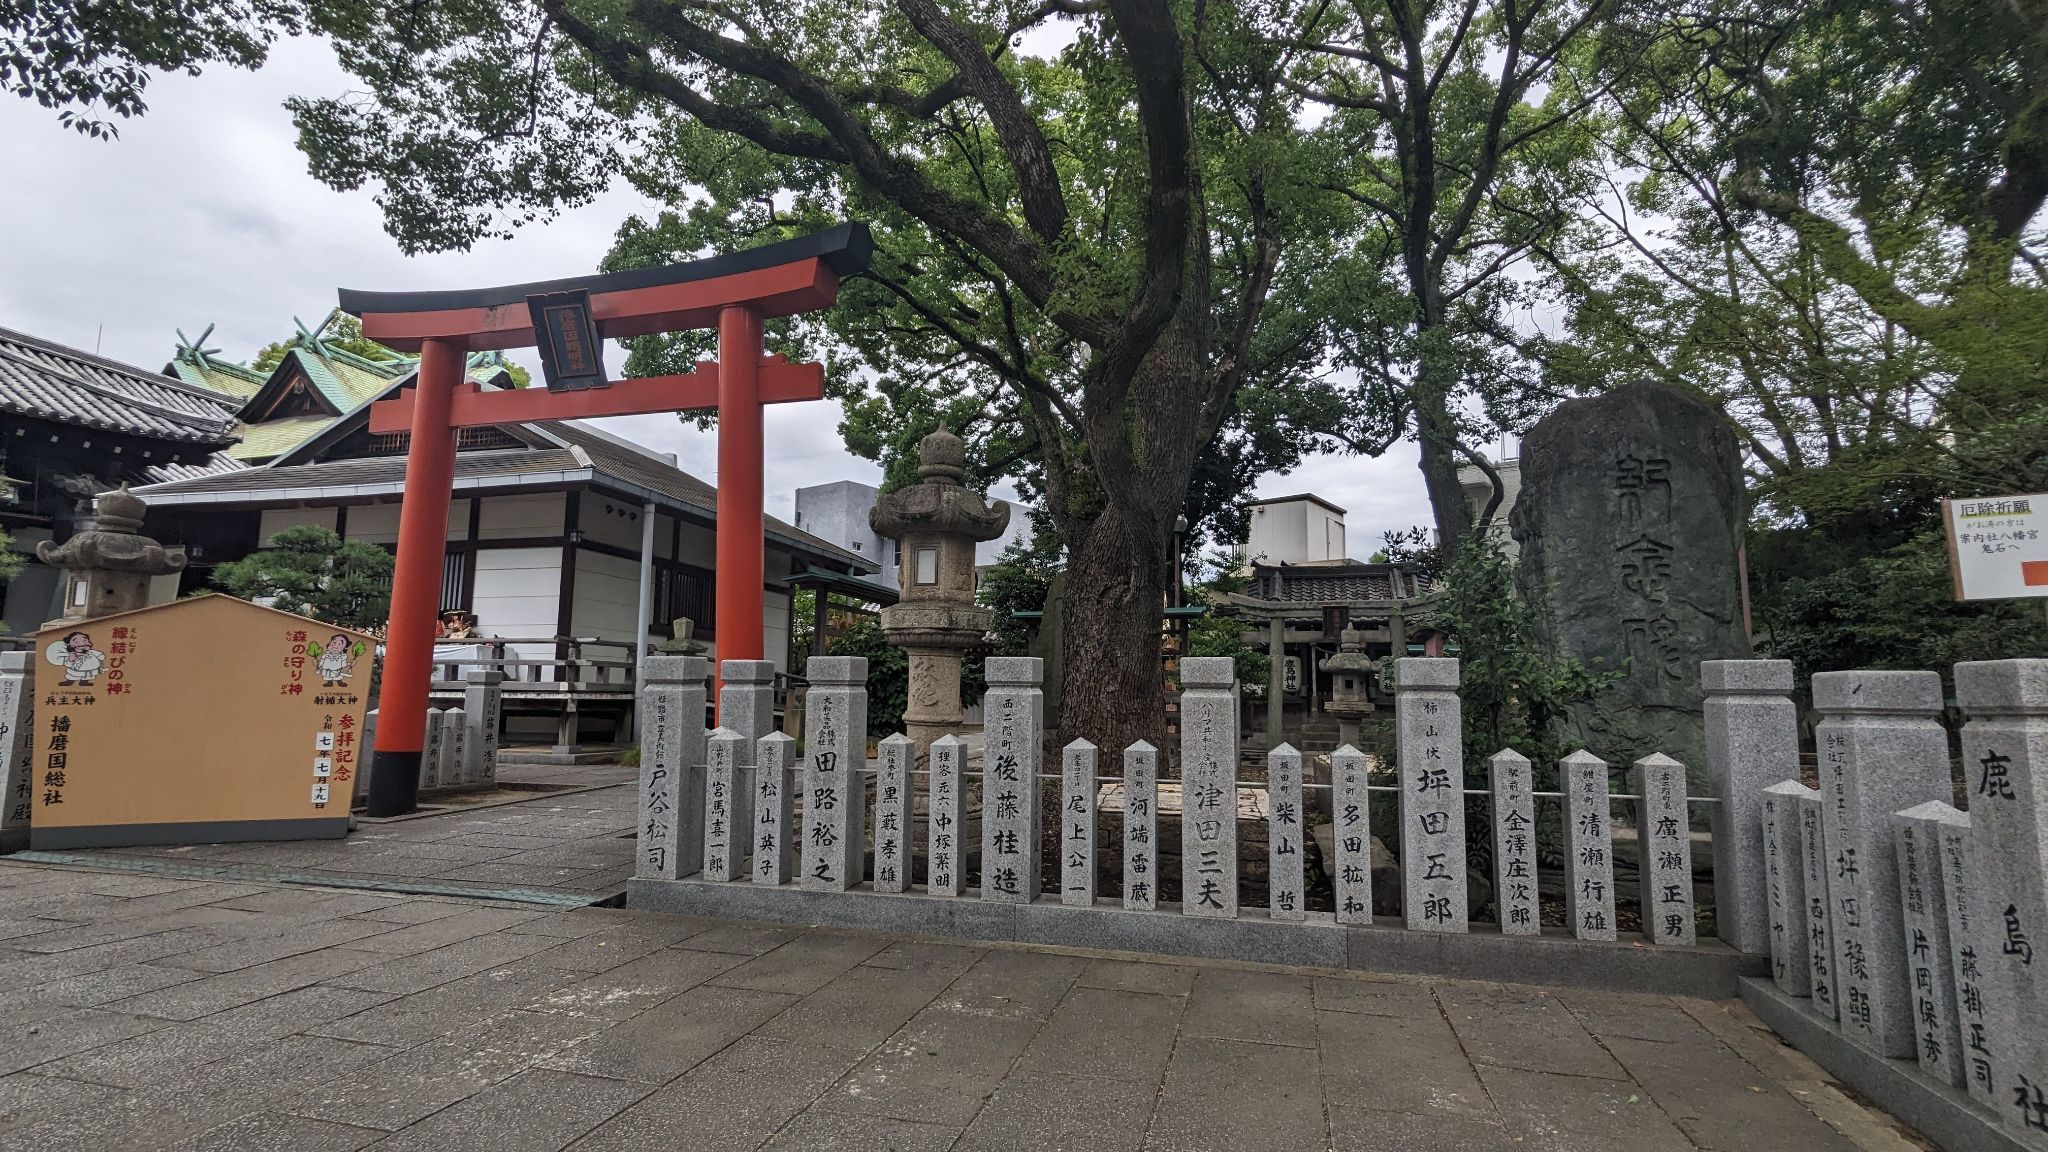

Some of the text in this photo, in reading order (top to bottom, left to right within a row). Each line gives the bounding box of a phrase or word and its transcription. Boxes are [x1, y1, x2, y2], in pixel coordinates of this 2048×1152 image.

[1960, 530, 2038, 544] 案内社八幡宮
[1961, 500, 2031, 516] 厄除祈願
[1983, 543, 2020, 553] 鬼石へ
[45, 695, 96, 706] 兵主大神
[107, 626, 128, 695] 縁結びの神
[289, 630, 307, 696] 森の守り神
[313, 696, 358, 705] 射楯大神
[42, 715, 71, 807] 播磨国総社
[314, 713, 333, 809] 令和七年七月十九日
[333, 713, 356, 782] 参拝記念
[1002, 698, 1013, 750] 西二階町
[1424, 701, 1441, 760] 柿山伏
[646, 764, 670, 872] 戸谷松司
[811, 751, 838, 882] 田路裕之
[1135, 756, 1144, 789] 坂田町
[1279, 760, 1291, 795] 坂田町
[1346, 762, 1356, 796] 坂田町
[1507, 768, 1520, 804] 駅前町
[760, 781, 777, 876] 松山英子
[935, 812, 952, 888] 中塚繁明
[993, 754, 1020, 895] 後藤桂造
[1067, 795, 1087, 892] 尾上公一
[1195, 783, 1225, 910] 津田三夫
[1276, 802, 1297, 912] 柴山哲
[1342, 804, 1365, 915] 多田拡和
[1417, 768, 1453, 926] 坪田五郎
[1503, 809, 1531, 926] 金澤庄次郎
[1578, 813, 1608, 932] 清瀬行雄
[1655, 816, 1686, 938] 廣瀬正男
[1811, 897, 1831, 1005] 西村拓也
[1912, 928, 1943, 1064] 片岡保秀
[1959, 945, 1994, 1095] 藤掛正司
